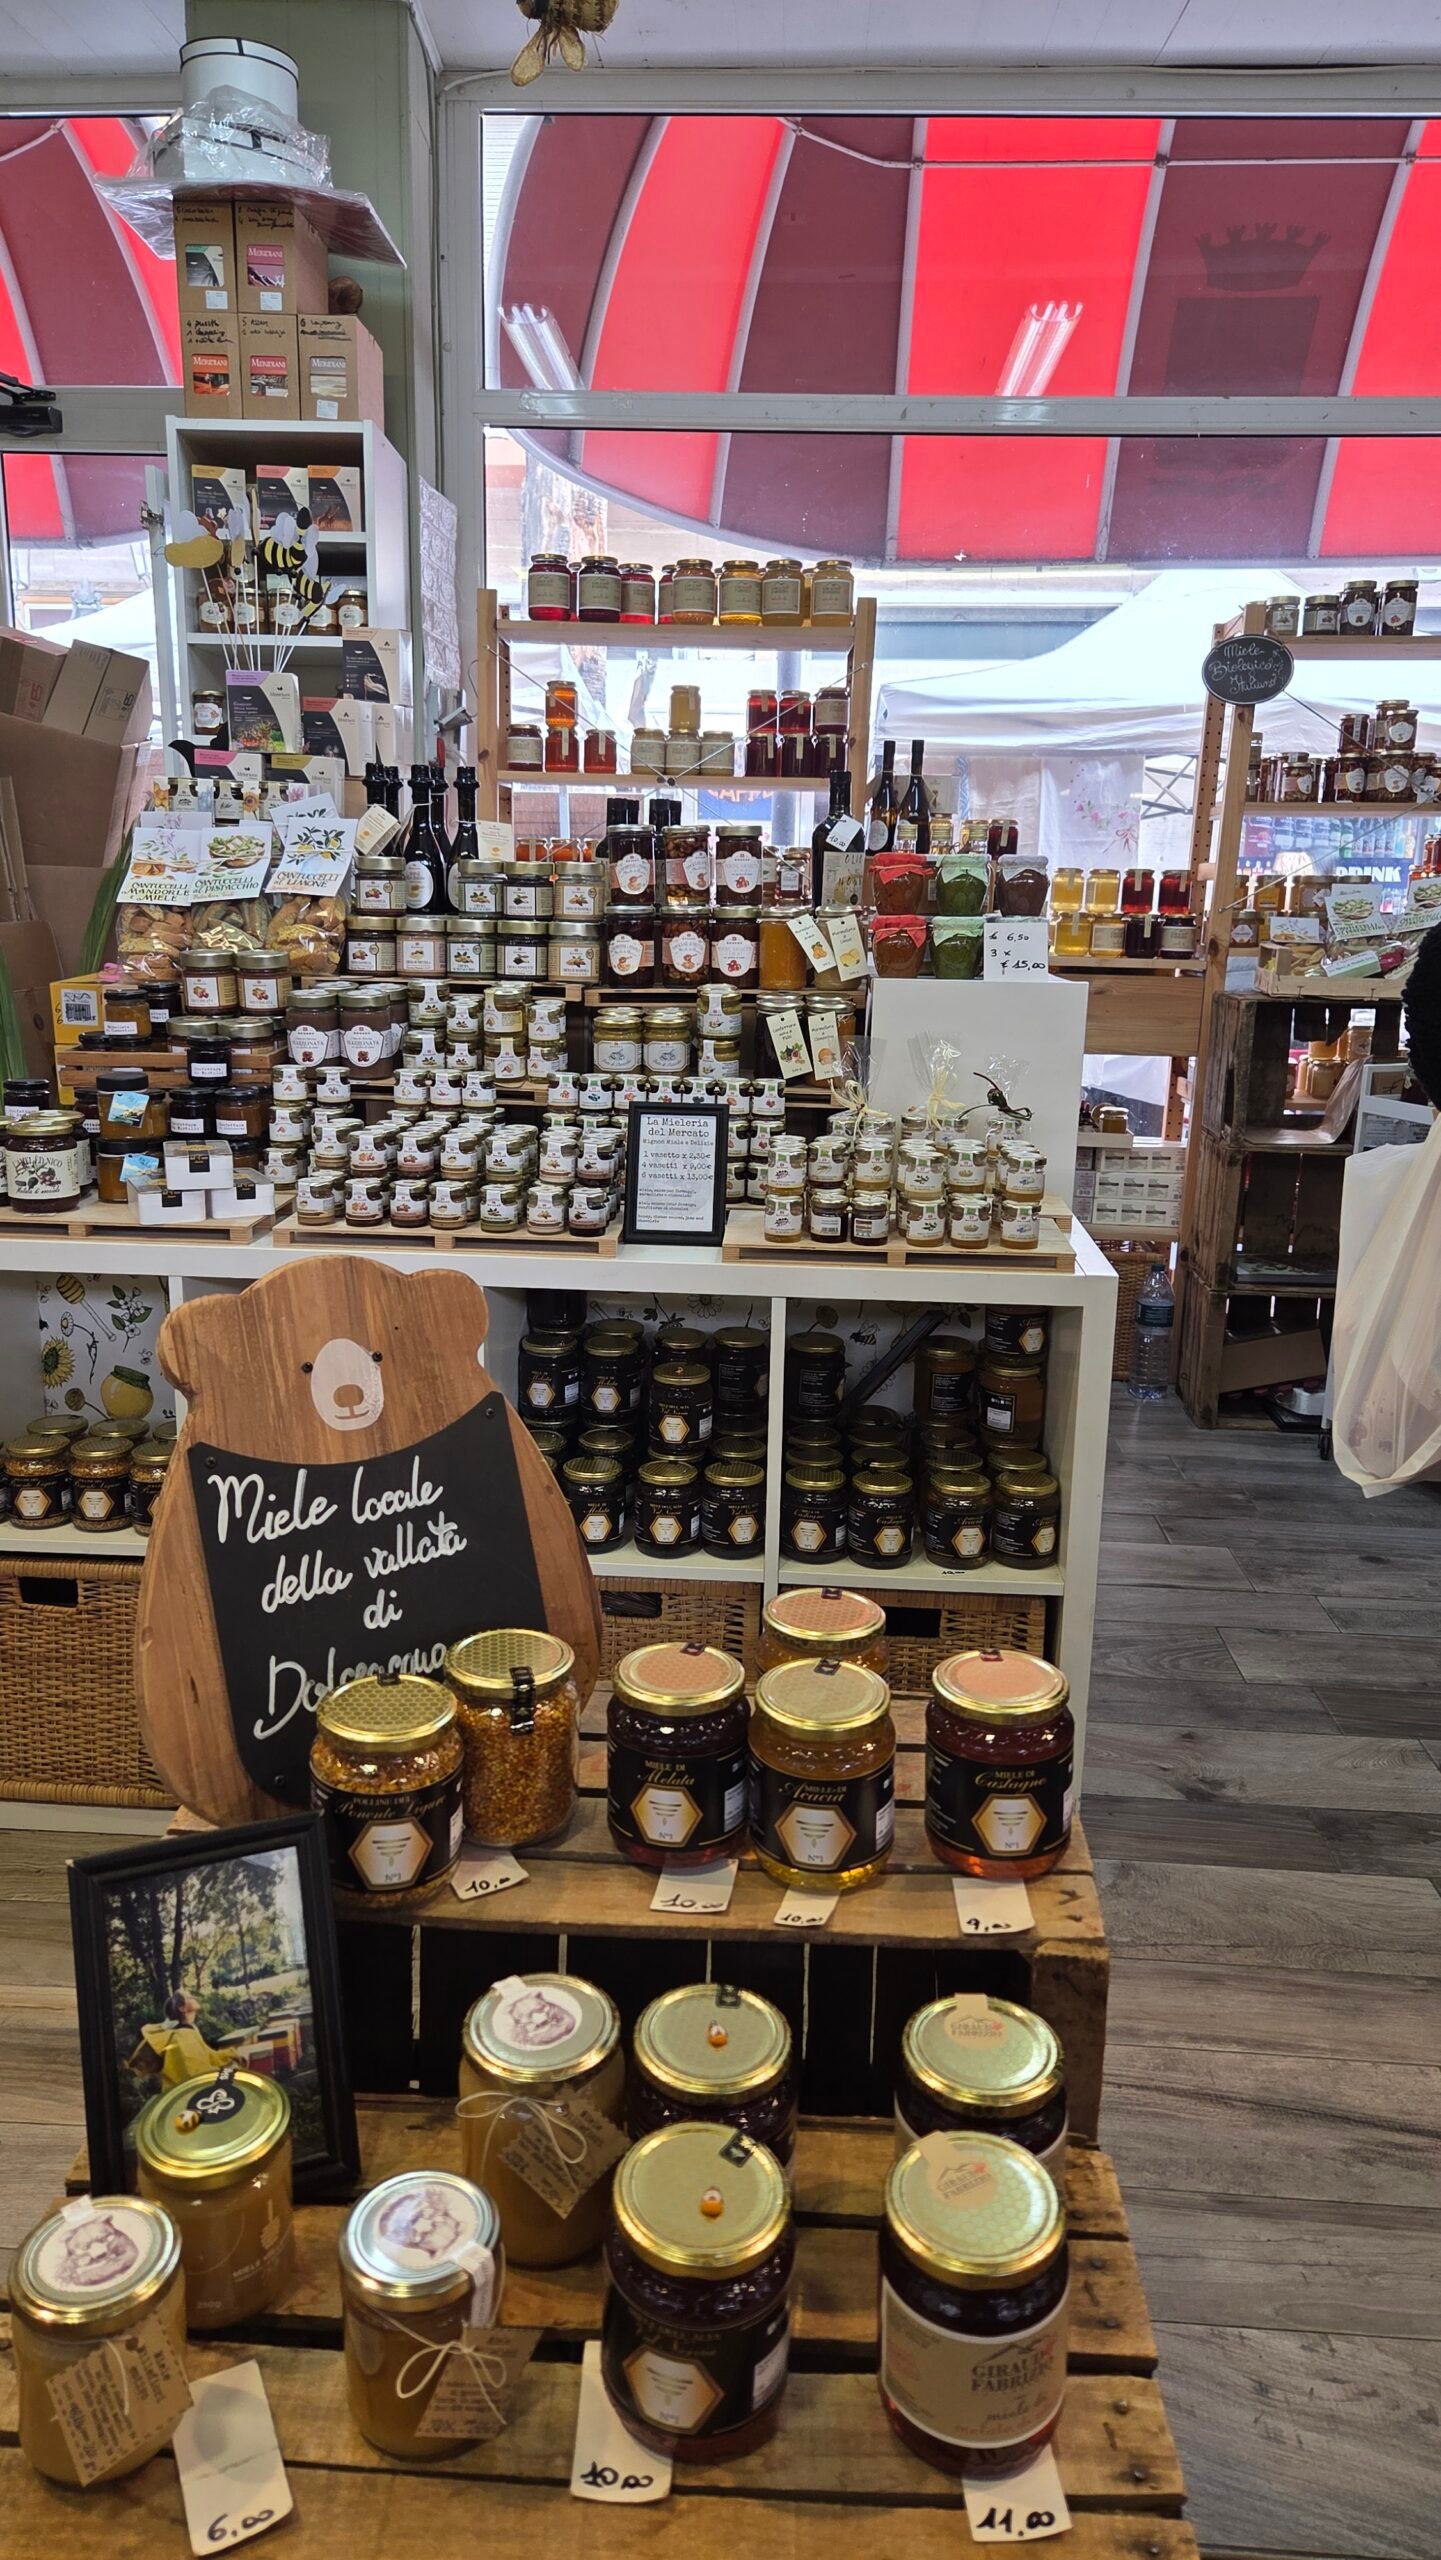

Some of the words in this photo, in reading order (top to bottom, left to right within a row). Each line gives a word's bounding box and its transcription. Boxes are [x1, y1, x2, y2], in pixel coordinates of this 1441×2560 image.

[286, 880, 328, 888] LIMONE
[1007, 932, 1030, 942] 6,50
[990, 948, 997, 957] 3
[1011, 959, 1046, 971] 15,00
[647, 1116, 659, 1125] La
[662, 1117, 709, 1128] Mieleria
[648, 1127, 665, 1136] del
[668, 1128, 710, 1138] Mercato
[207, 1468, 338, 1543] Miele
[261, 1549, 354, 1614] della
[363, 1511, 468, 1579] vallata
[363, 1588, 403, 1630] di
[644, 1760, 672, 1770] MIELE
[675, 1762, 686, 1771] DI
[638, 1769, 696, 1786] Melata
[994, 1769, 1023, 1779] MIELE
[1025, 1770, 1035, 1778] DI
[778, 1781, 847, 1802] Acacia
